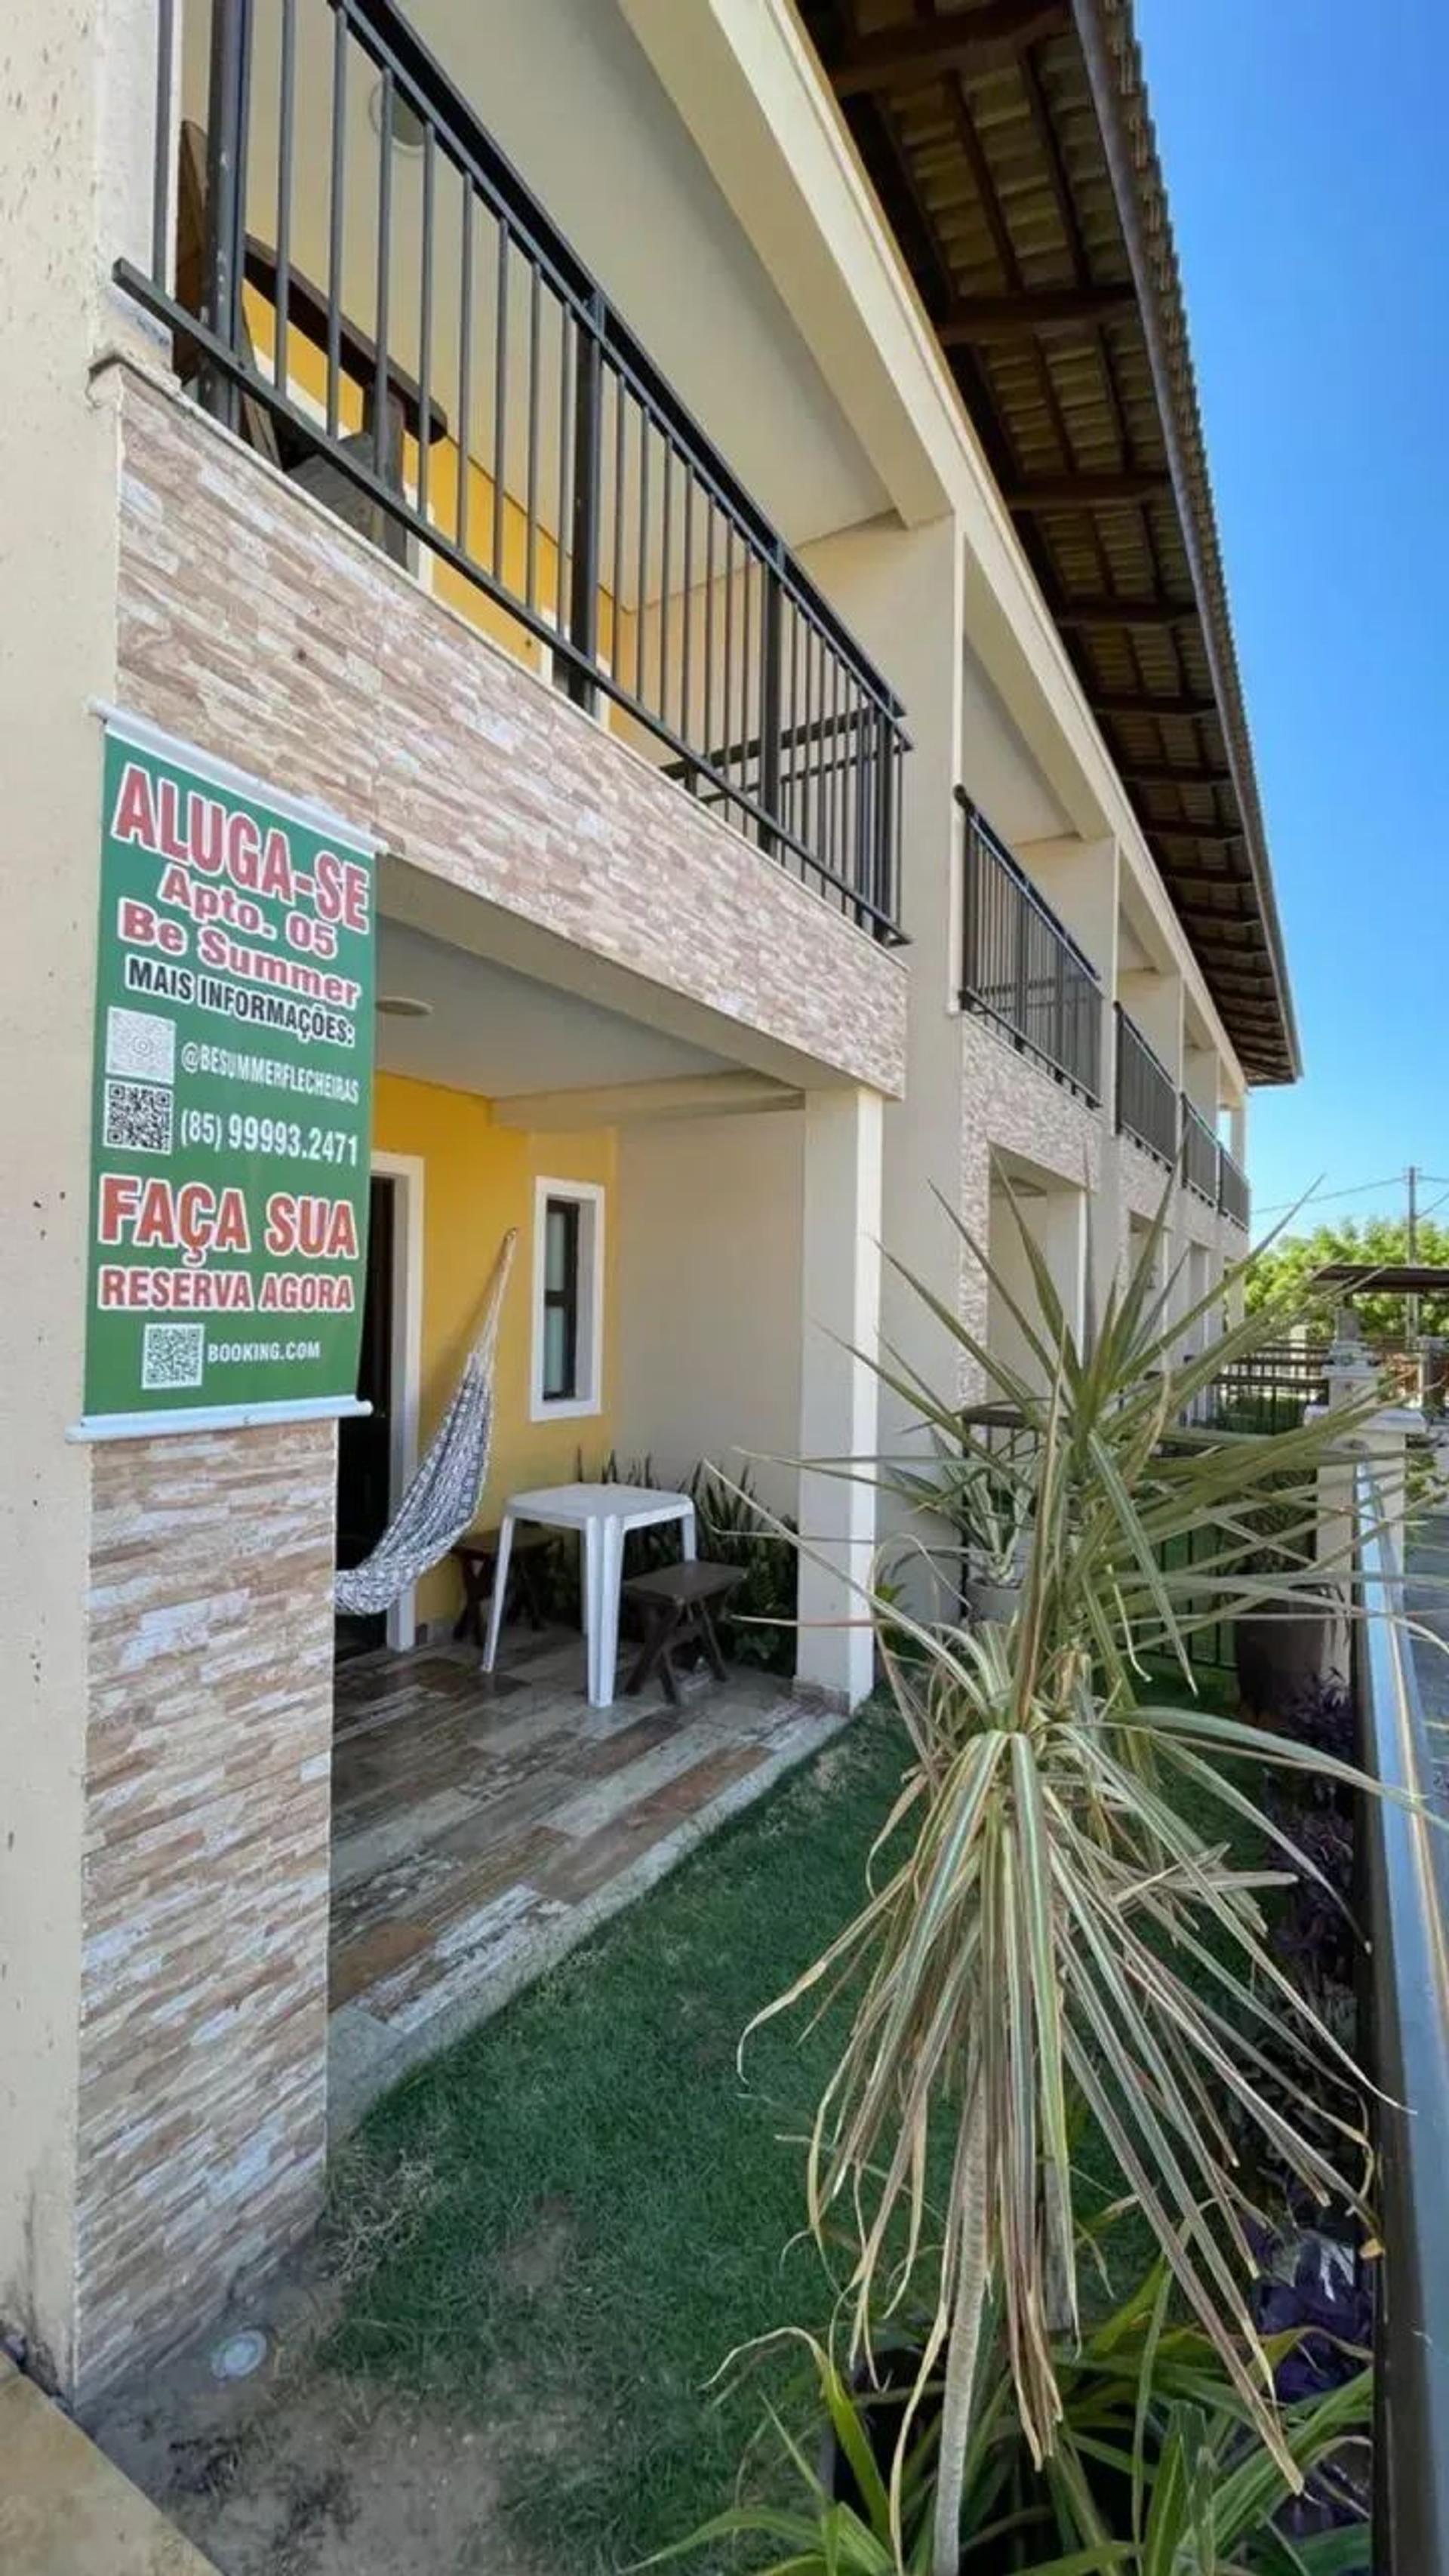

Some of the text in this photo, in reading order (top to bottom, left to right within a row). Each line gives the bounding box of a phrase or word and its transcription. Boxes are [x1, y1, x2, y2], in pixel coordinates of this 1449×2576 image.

[112, 762, 368, 933] ALUGA-SE
[118, 897, 361, 1010] Be Summer
[158, 864, 337, 959] Apto. 05
[126, 956, 355, 1047] MAIS INFORMAÇÕES:
[182, 1042, 358, 1105] @BESUMMERFLECHEIRAS
[181, 1109, 358, 1166] (85) 99993.2471
[98, 1174, 358, 1266] FAÇA SUA
[98, 1266, 354, 1312] RESERVA AGORA
[208, 1341, 320, 1362] BOOKING.COM
